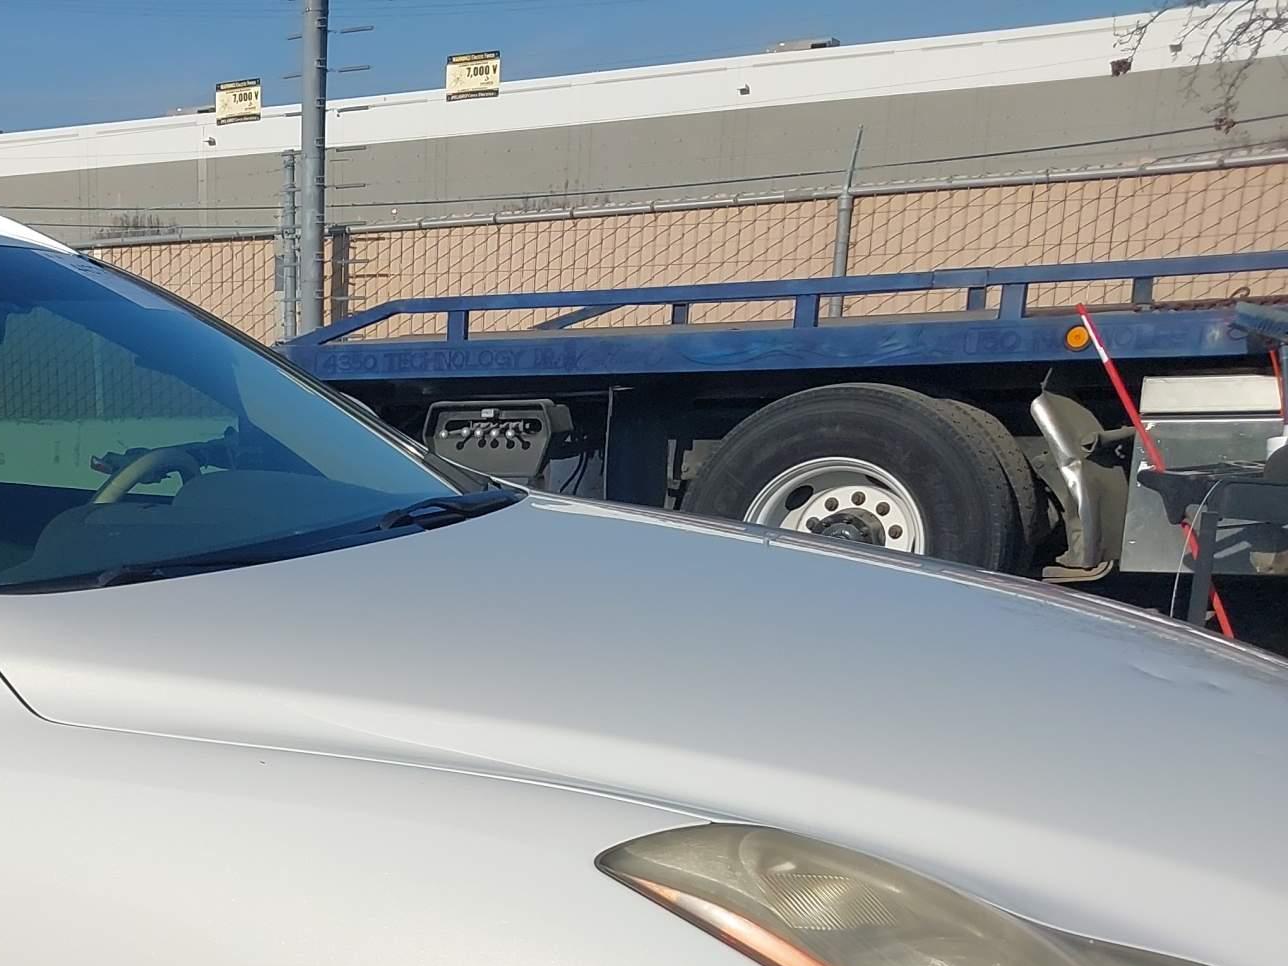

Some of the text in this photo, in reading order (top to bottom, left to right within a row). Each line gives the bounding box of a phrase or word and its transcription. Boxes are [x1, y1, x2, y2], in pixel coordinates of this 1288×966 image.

[466, 64, 498, 79] 7,000 V
[232, 90, 259, 104] 7,000 V
[383, 349, 519, 371] TECHNOLOGY
